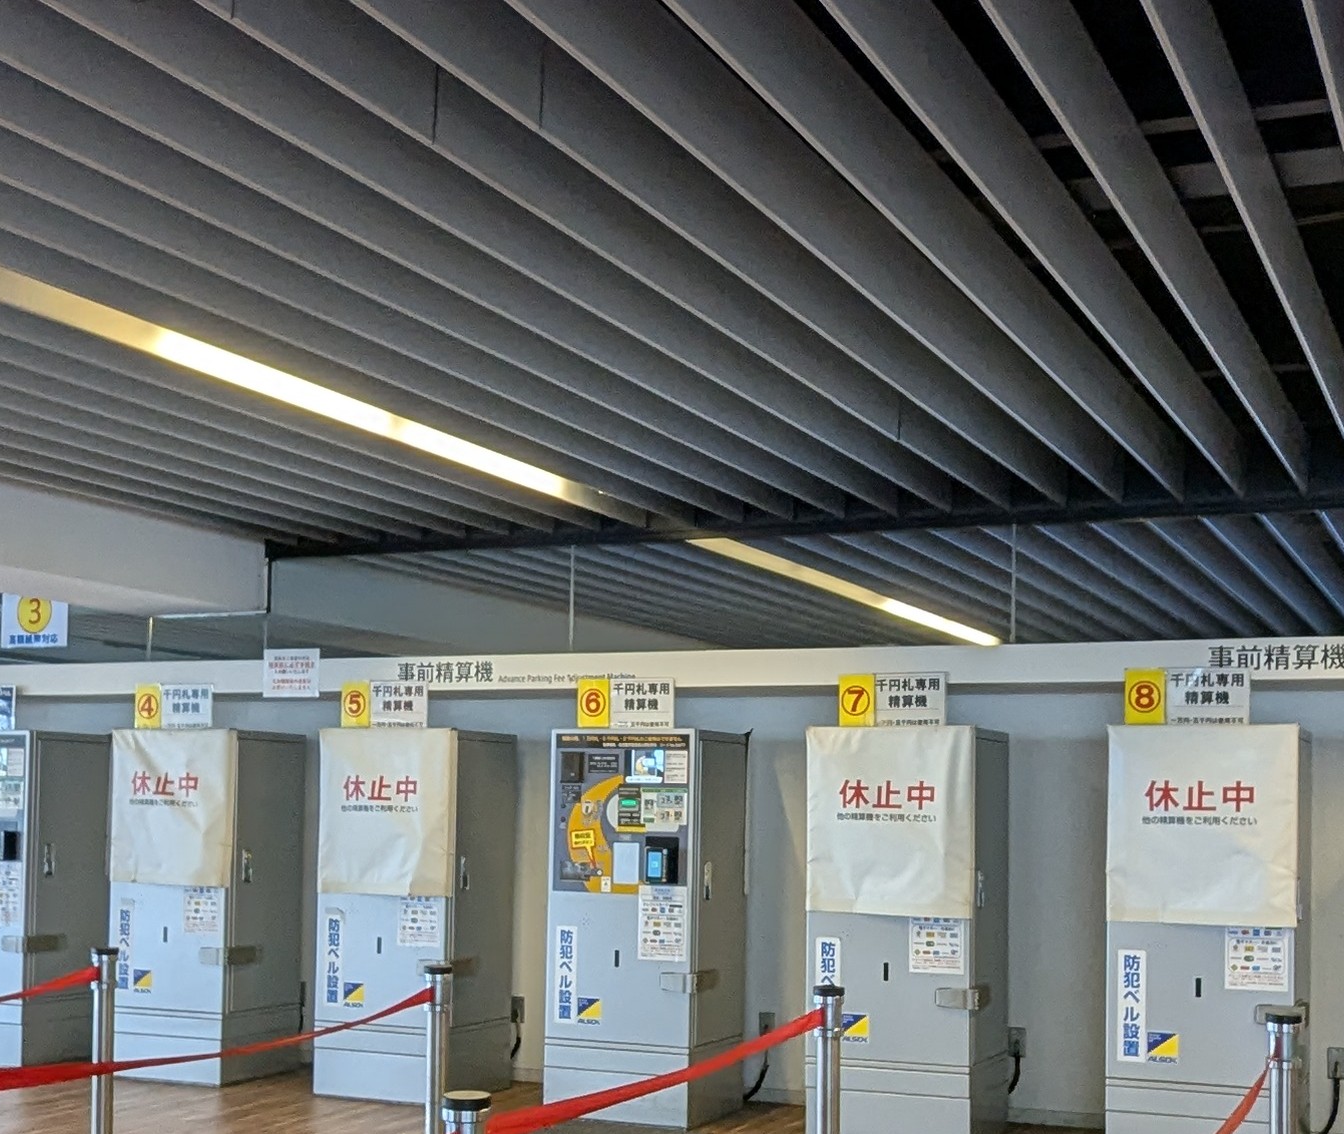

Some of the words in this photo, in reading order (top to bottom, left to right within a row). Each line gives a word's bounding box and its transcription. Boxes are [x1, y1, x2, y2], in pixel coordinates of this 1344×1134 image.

[28, 598, 41, 625] 3
[397, 661, 493, 684] 事前精算機
[498, 673, 525, 683] Advance
[527, 673, 553, 684] Parking
[554, 673, 566, 682] Fee
[876, 678, 940, 693] 千円札専用
[1170, 673, 1245, 688] 千円札専用
[372, 685, 424, 697] 千円札専用
[613, 682, 670, 695] 千円札専用
[624, 698, 659, 711] 精算機
[888, 694, 928, 708] 精算機
[1184, 690, 1230, 705] 精算機
[383, 700, 413, 711] 精算機
[131, 770, 199, 798] 休止中
[343, 774, 418, 803] 休止中
[839, 779, 935, 811] 休止中
[1144, 779, 1255, 813] 休止中
[1142, 815, 1258, 826] 他の精算機をご利用ください
[820, 941, 836, 987] 防犯ベ
[558, 929, 574, 1020] 防犯ベル設置
[1123, 954, 1141, 1058] 防犯ベル設置
[1147, 1056, 1178, 1065] ALSOK
